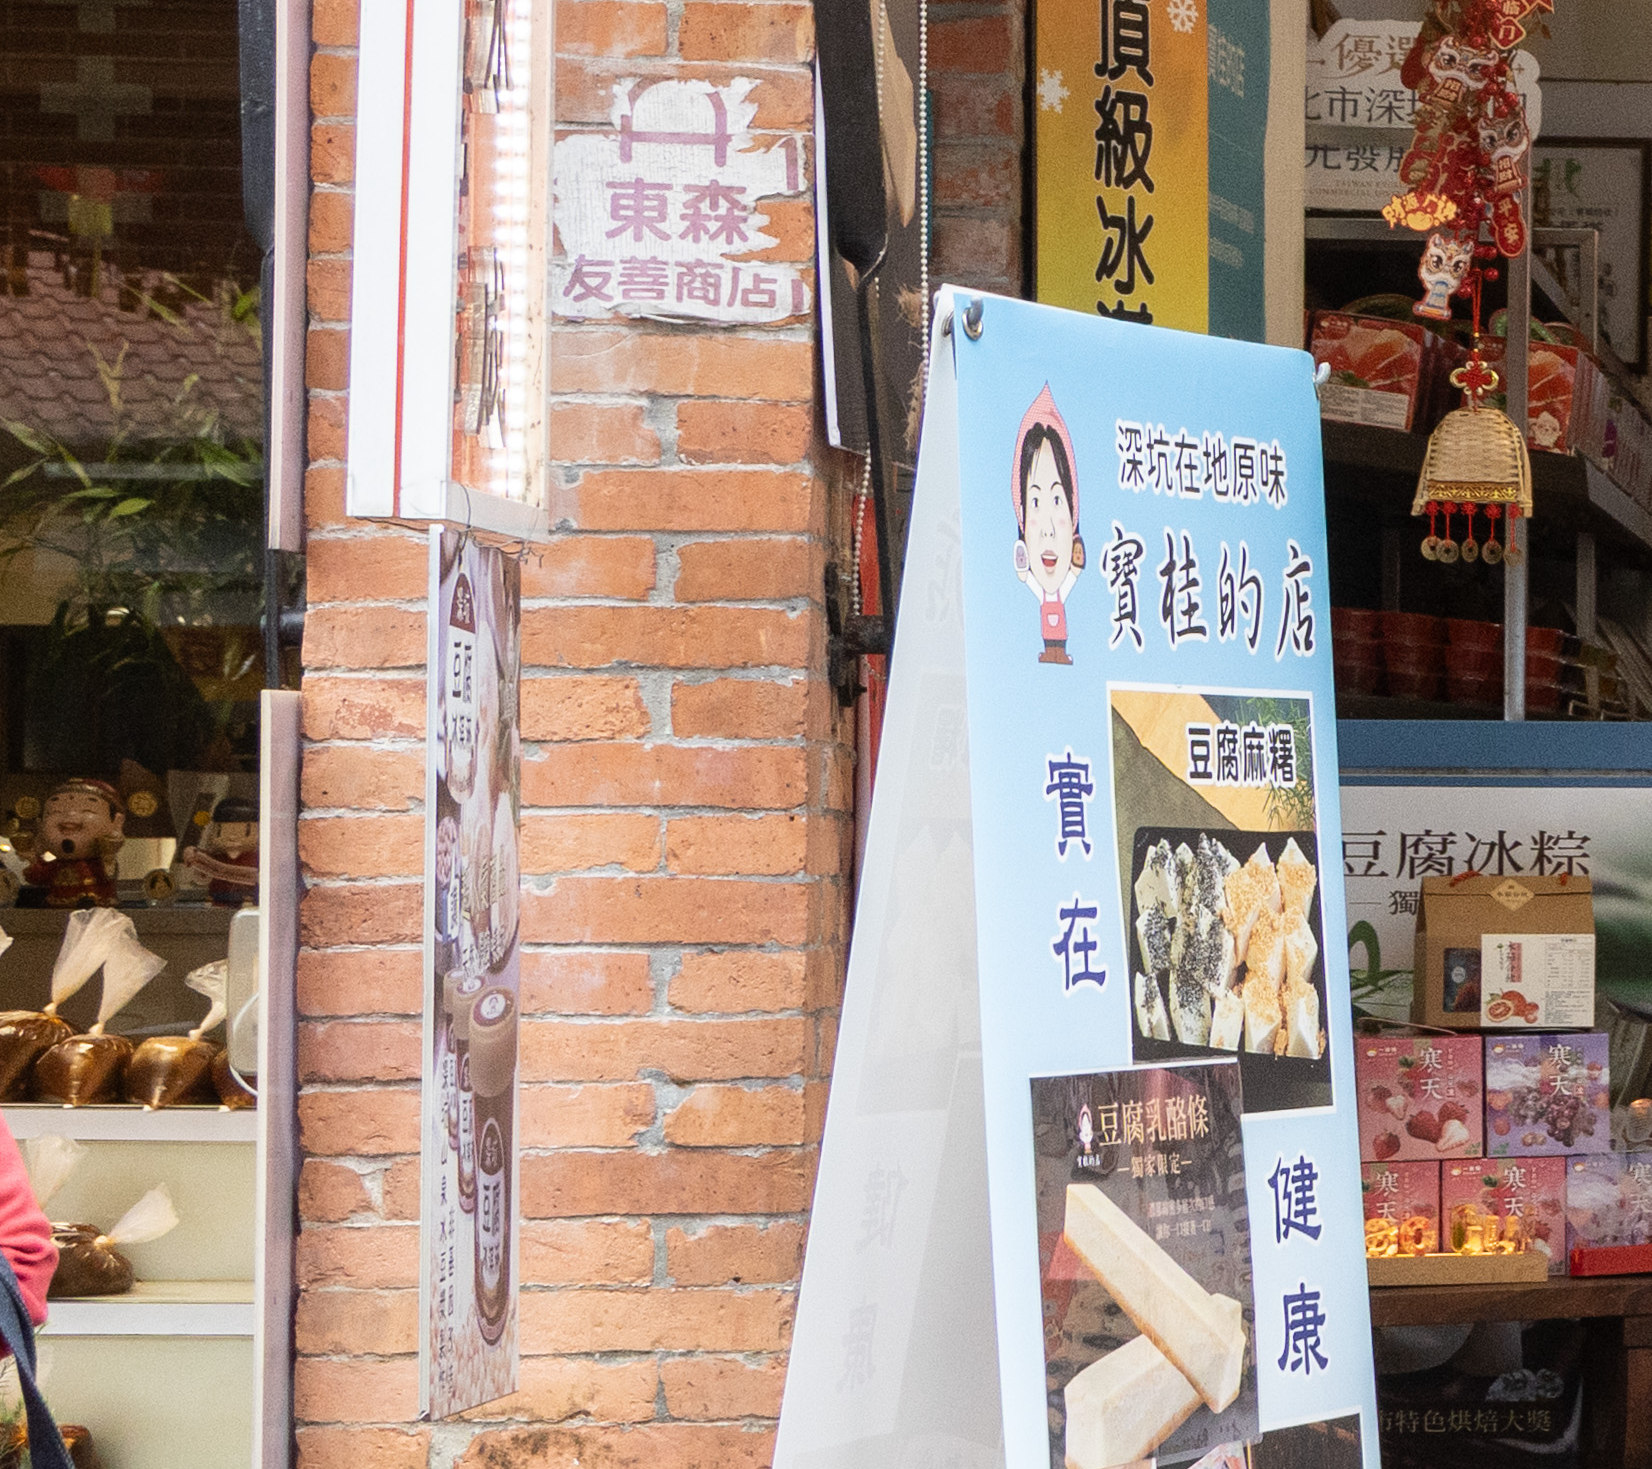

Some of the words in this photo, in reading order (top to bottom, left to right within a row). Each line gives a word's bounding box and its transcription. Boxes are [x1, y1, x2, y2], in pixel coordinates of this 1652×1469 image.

[605, 177, 756, 246] 東森
[1117, 426, 1288, 508] 深坑在地原味
[1102, 525, 1316, 659] 寶桂的店
[1187, 723, 1296, 784] 豆腐麻糬
[1046, 756, 1107, 990] 實在
[1419, 1046, 1445, 1101] 寒天
[1548, 1044, 1573, 1099] 寒天
[1098, 1093, 1210, 1147] 豆腐乳酪條
[1127, 1154, 1182, 1179] 獨家限定
[1502, 1166, 1527, 1218] 寒天
[1268, 1155, 1329, 1376] 健康
